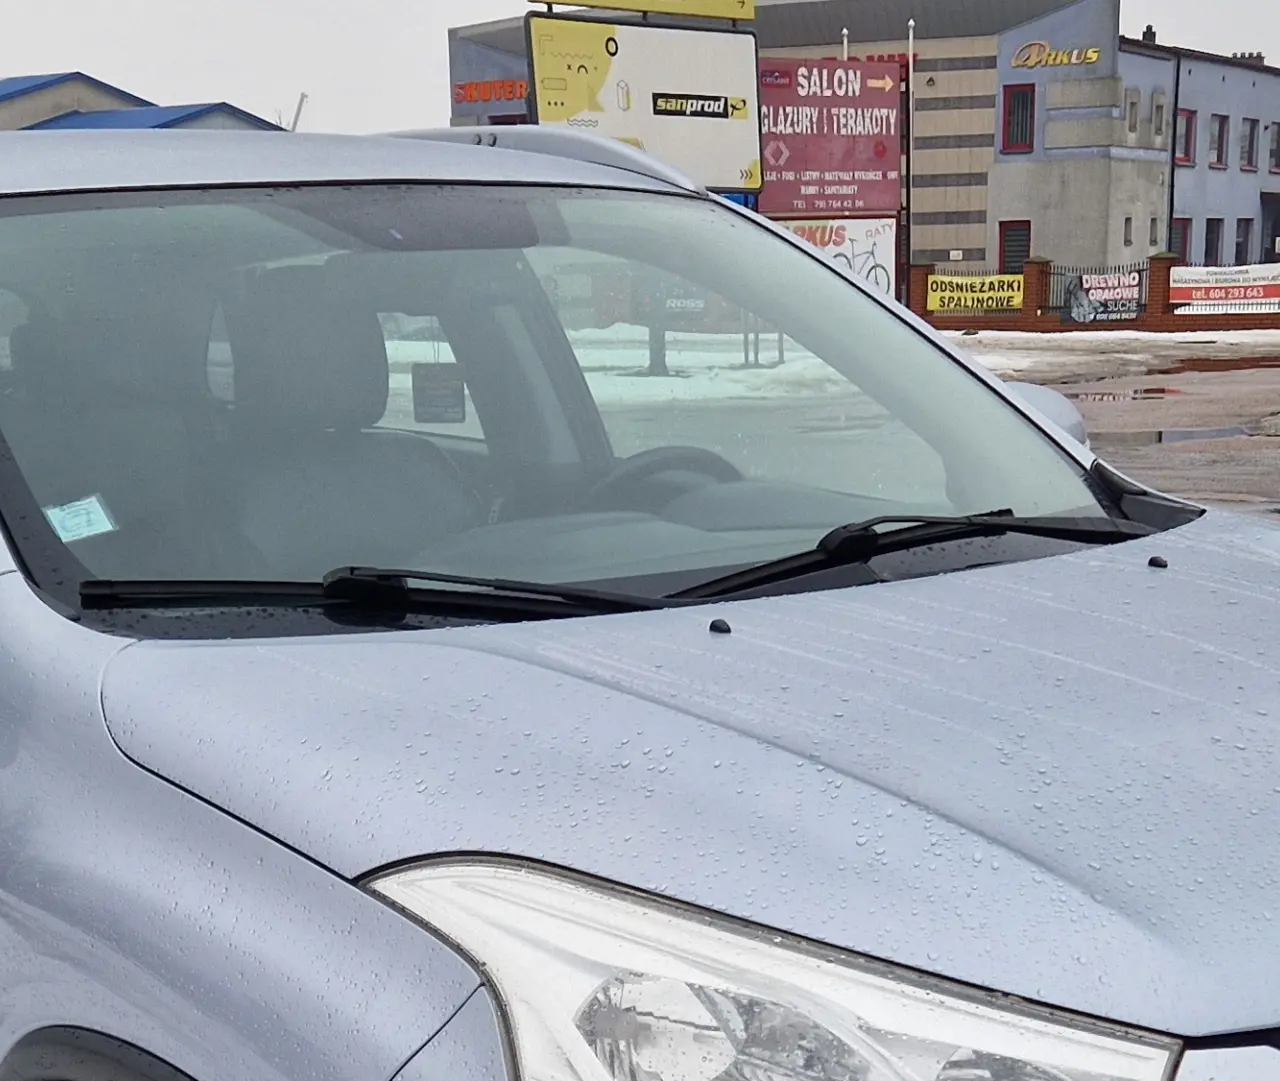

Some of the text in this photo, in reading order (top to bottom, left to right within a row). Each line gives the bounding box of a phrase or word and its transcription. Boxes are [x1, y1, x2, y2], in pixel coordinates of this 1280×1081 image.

[796, 66, 862, 97] SALON
[656, 97, 726, 115] sanprod
[760, 105, 819, 135] GLAZURY
[831, 107, 897, 136] TERAKOTY
[865, 222, 894, 241] RATY
[1082, 272, 1140, 289] DREWNO
[1208, 288, 1226, 299] 604
[1228, 288, 1245, 298] 293
[1246, 287, 1264, 298] 643
[939, 295, 1015, 310] SPALINOWE
[1107, 300, 1138, 311] SUCHE
